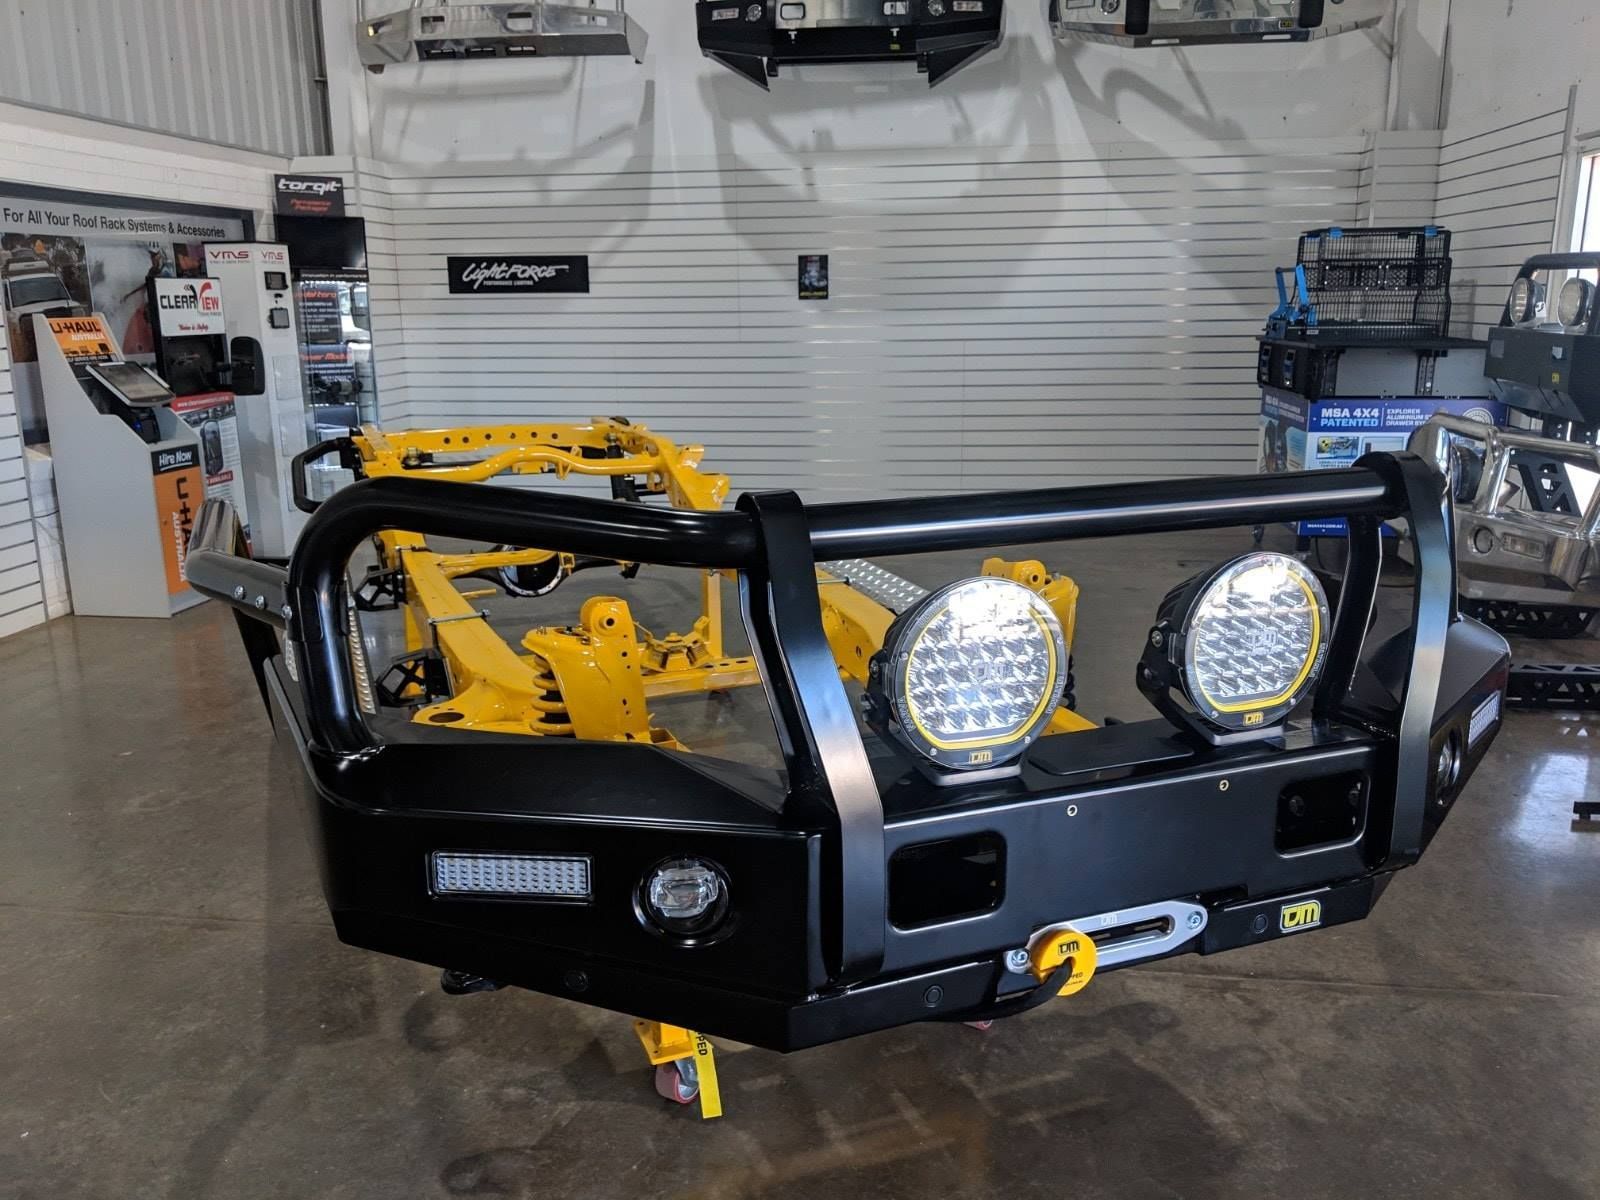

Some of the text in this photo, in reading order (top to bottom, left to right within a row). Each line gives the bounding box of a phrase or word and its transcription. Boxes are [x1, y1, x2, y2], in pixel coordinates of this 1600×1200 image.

[278, 178, 341, 195] torqit
[3, 207, 226, 238] For All Your Roof Rack Systems & Accessories
[1321, 408, 1380, 418] MSA 4X4
[1320, 418, 1379, 427] PATENTED
[159, 450, 193, 465] Hire Now
